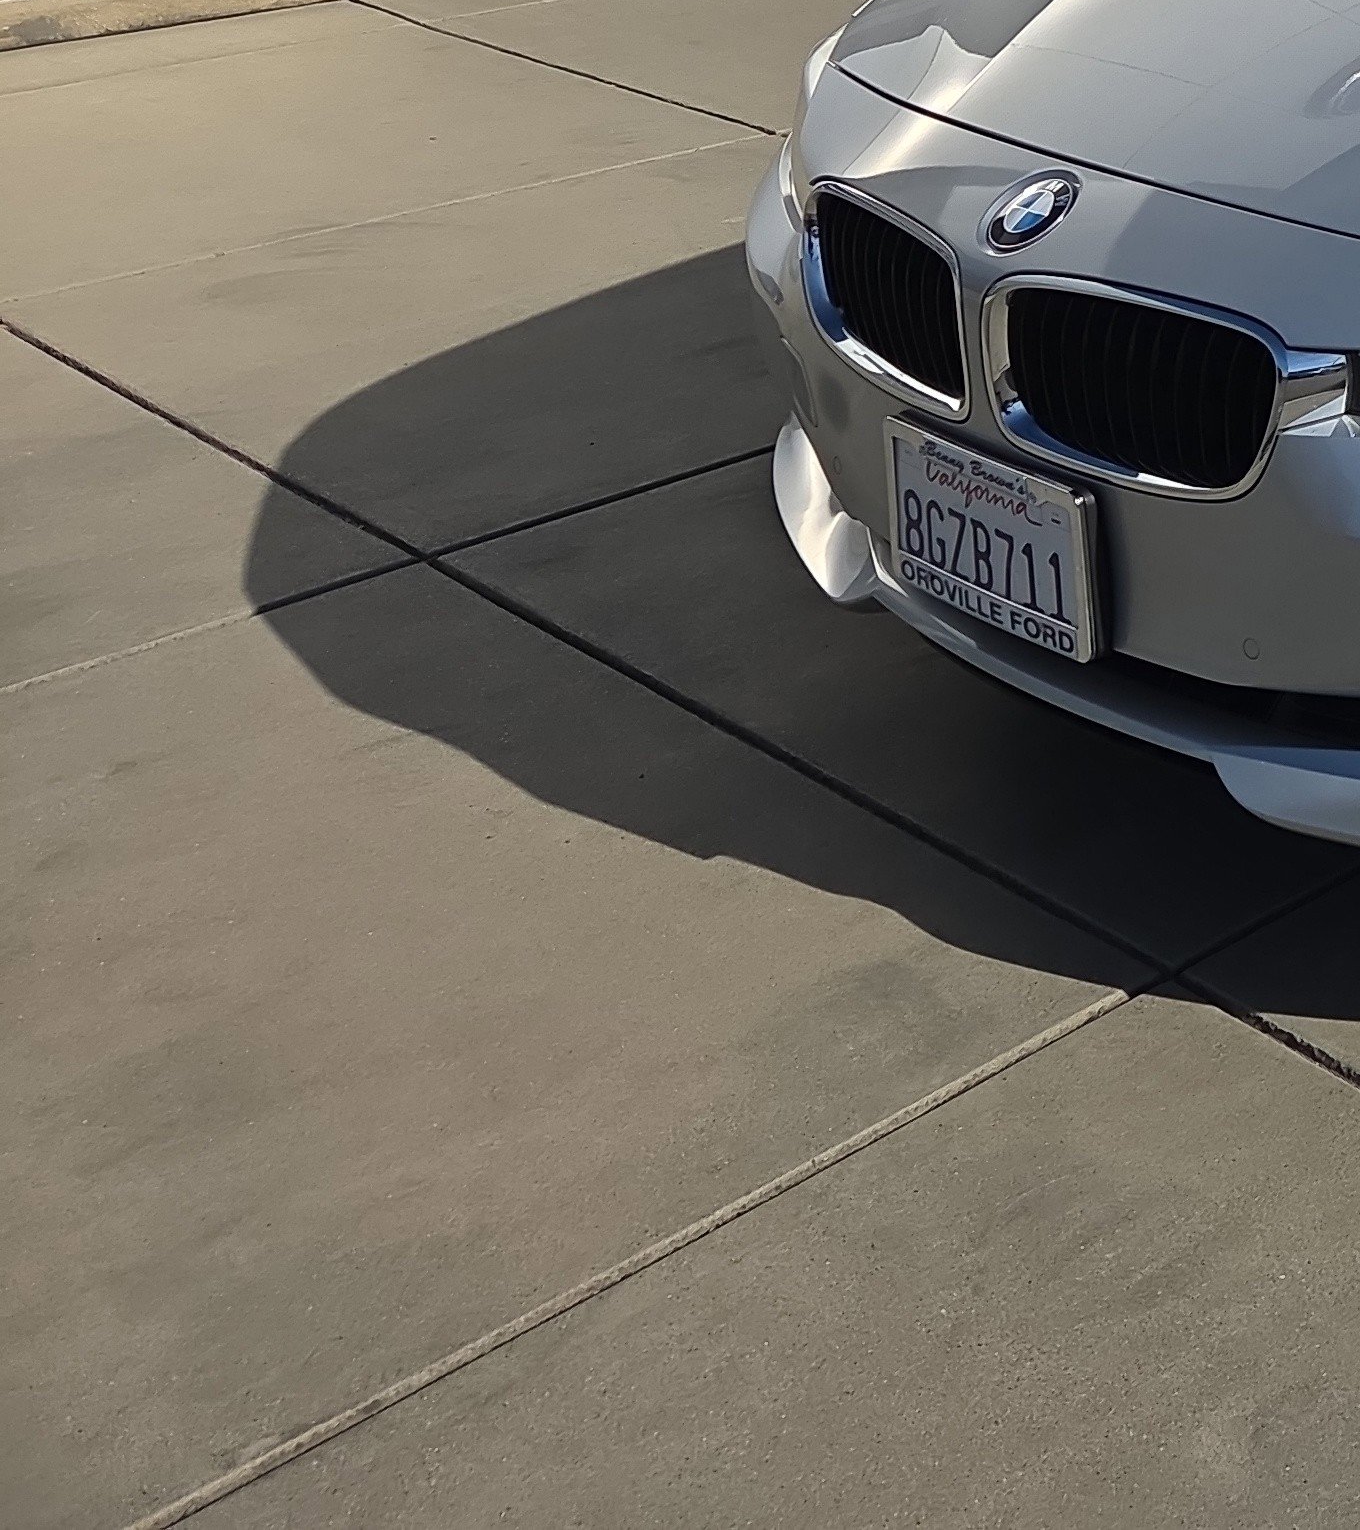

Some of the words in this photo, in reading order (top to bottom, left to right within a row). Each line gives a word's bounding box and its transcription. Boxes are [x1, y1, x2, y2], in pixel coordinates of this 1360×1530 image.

[925, 457, 1043, 527] California
[903, 488, 1073, 627] 8GZB711
[900, 560, 1004, 625] OROVILLE
[1010, 608, 1074, 654] FORD
